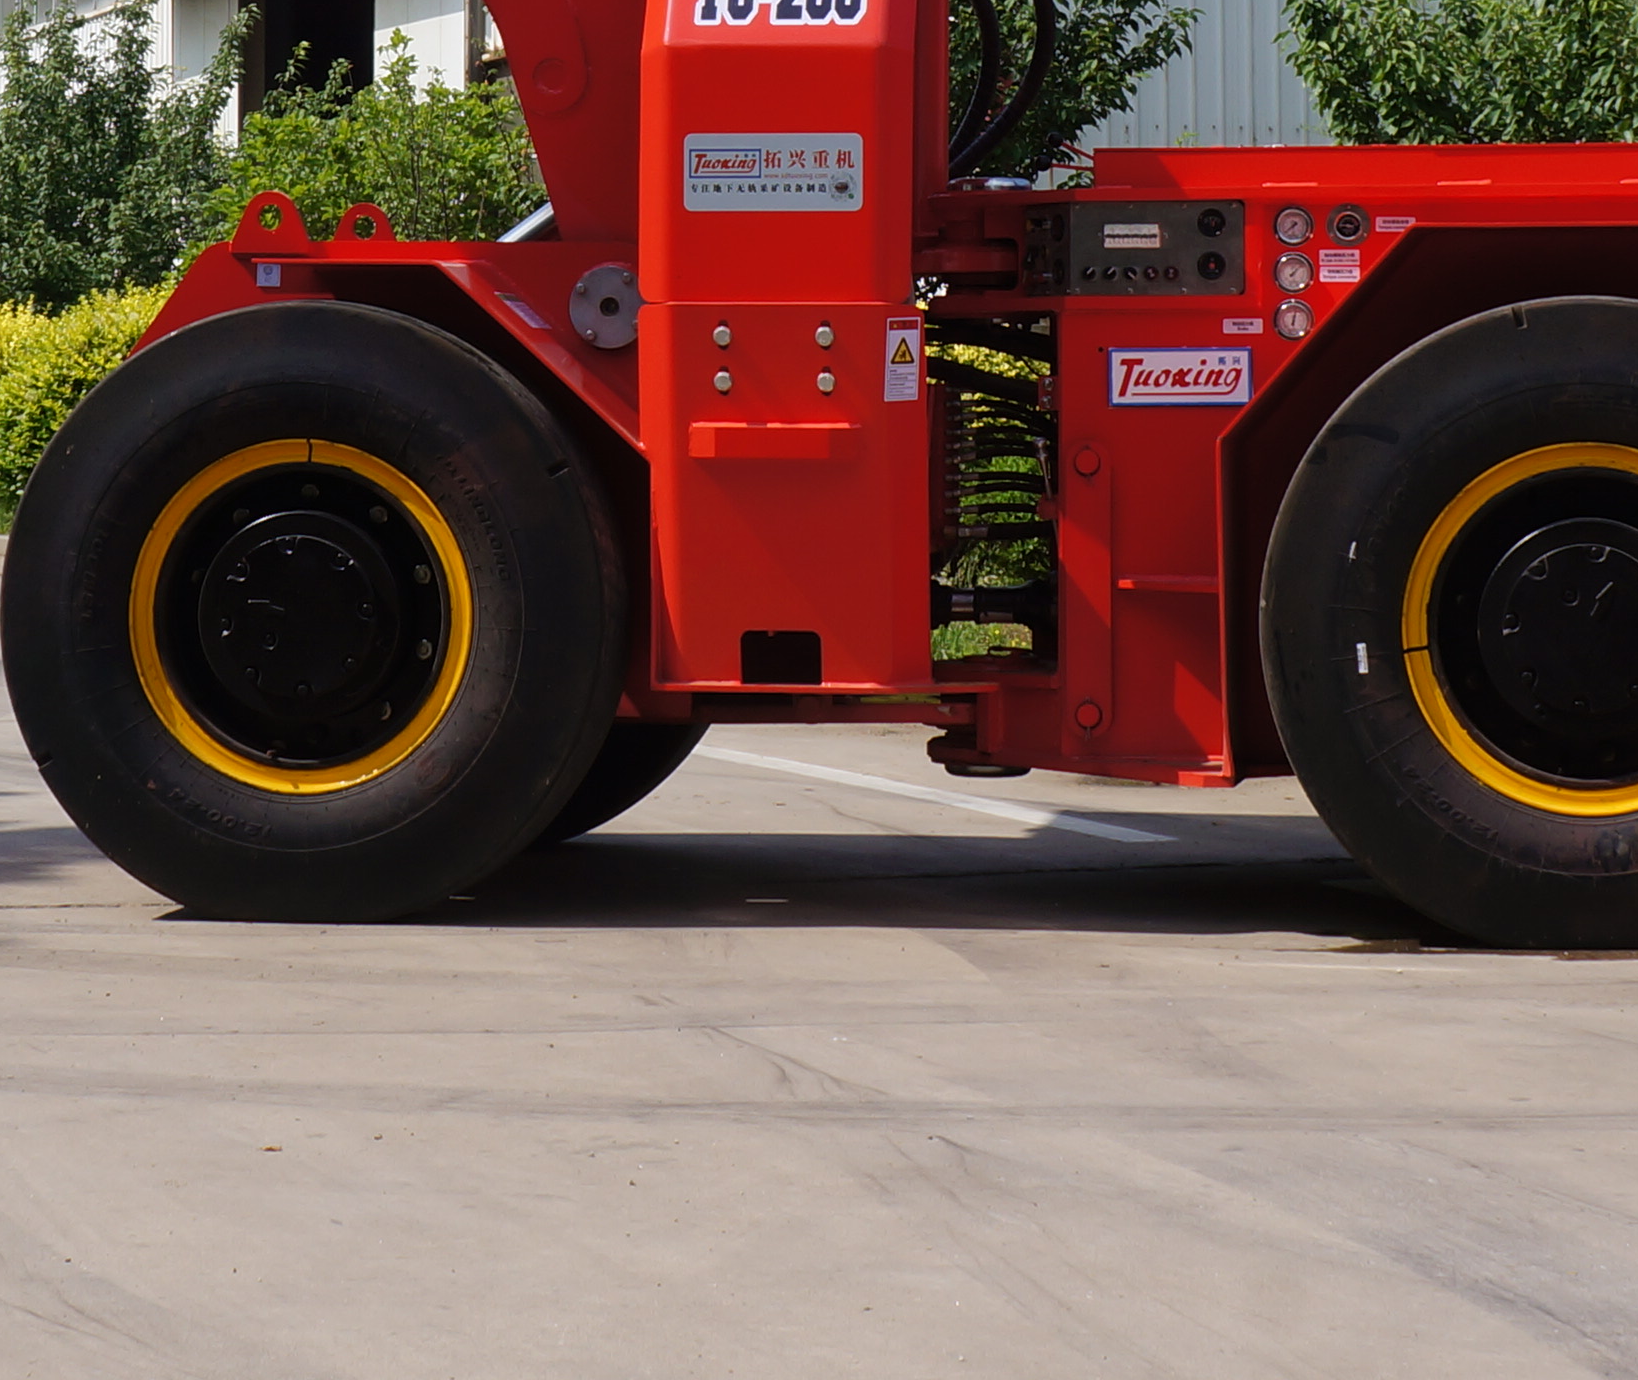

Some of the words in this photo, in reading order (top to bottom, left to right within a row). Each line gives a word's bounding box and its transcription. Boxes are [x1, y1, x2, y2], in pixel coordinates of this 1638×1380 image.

[693, 153, 757, 174] Tuoxing
[763, 149, 855, 169] 拓兴重机
[1118, 358, 1243, 397] Tuoxing
